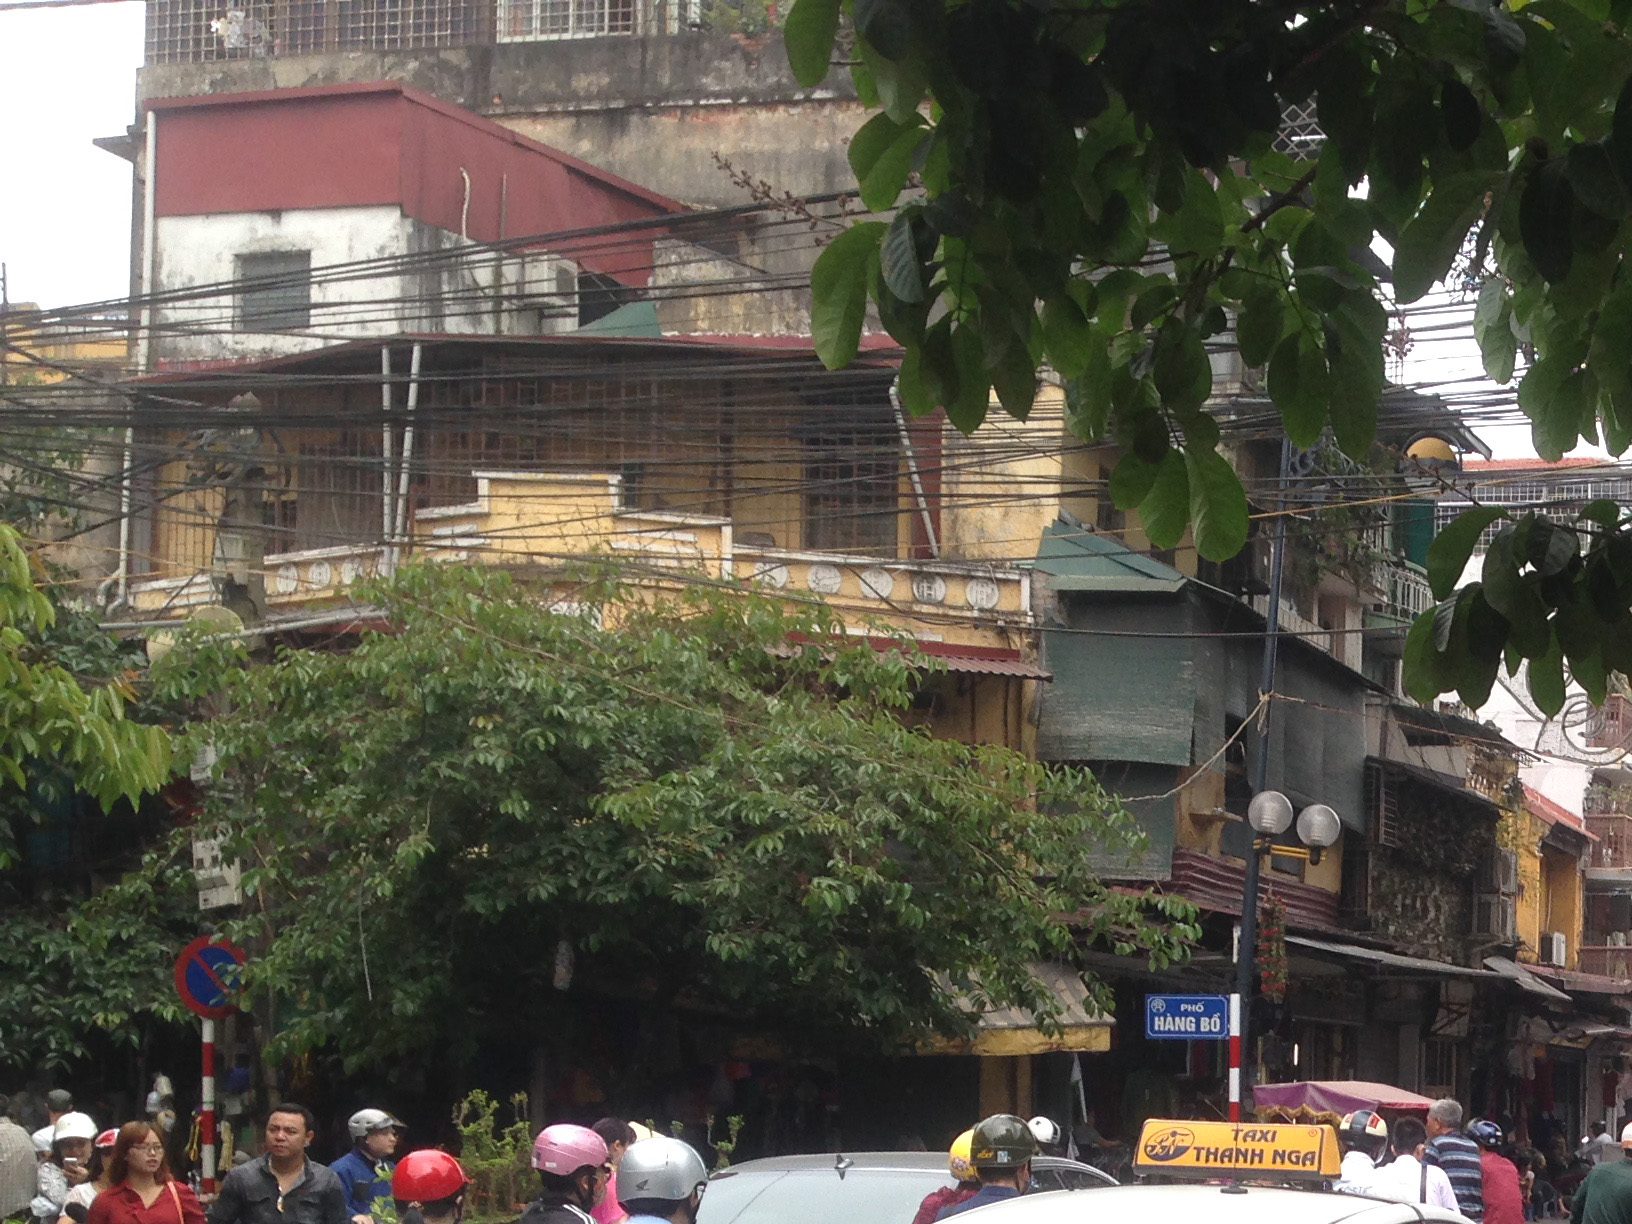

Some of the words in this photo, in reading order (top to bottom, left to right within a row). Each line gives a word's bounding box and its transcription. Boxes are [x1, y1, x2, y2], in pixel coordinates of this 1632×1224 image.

[1181, 1001, 1204, 1012] PHỐ
[1154, 1013, 1196, 1032] HÀNG
[1231, 1128, 1277, 1142] TAXI
[1193, 1146, 1264, 1165] THANH
[1271, 1149, 1316, 1166] NGA
